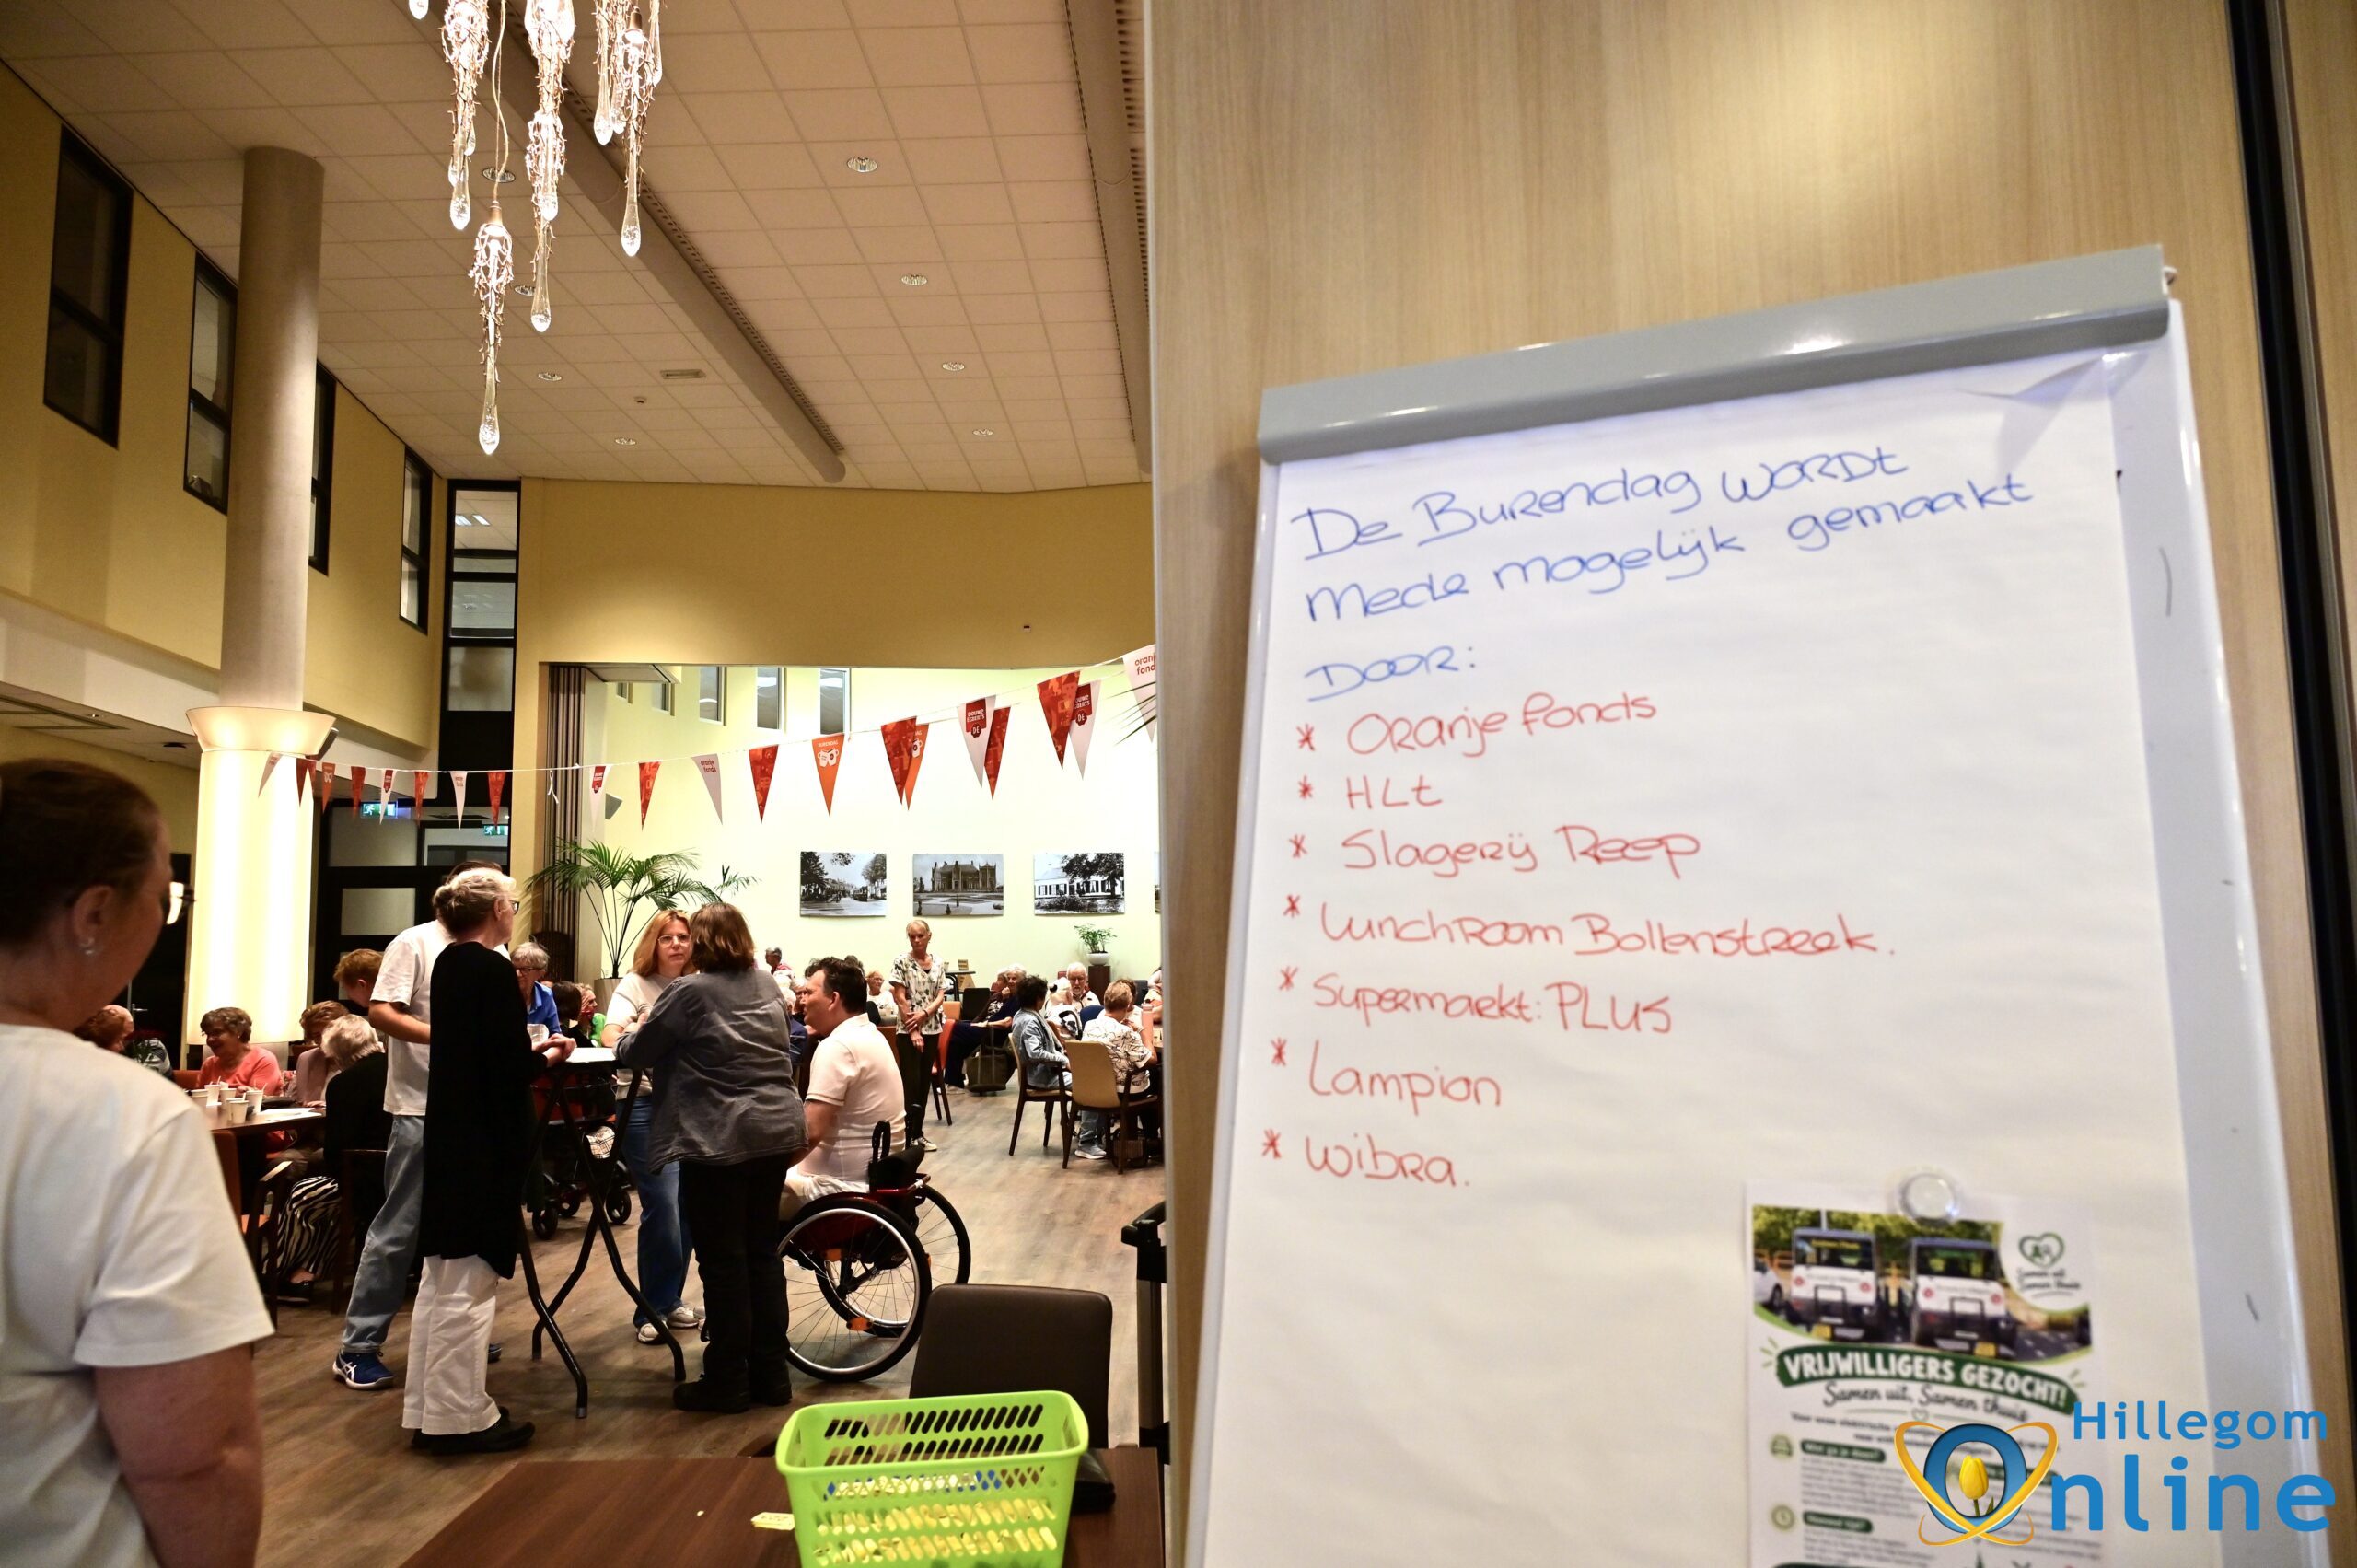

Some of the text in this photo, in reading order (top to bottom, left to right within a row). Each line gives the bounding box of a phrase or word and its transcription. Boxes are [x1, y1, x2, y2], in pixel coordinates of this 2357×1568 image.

[1291, 507, 1403, 561] De
[1787, 472, 2034, 552] gemaakt
[1137, 664, 1156, 675] fond
[972, 726, 980, 735] DE
[1077, 713, 1086, 722] DE
[1544, 981, 1672, 1034] PLUS
[1309, 1040, 1502, 1115] Lampion
[1783, 1350, 2068, 1408] VRIJWILLIGERS GEZOCHT!
[1822, 1381, 1881, 1407] Samen
[1918, 1383, 1978, 1412] Samen
